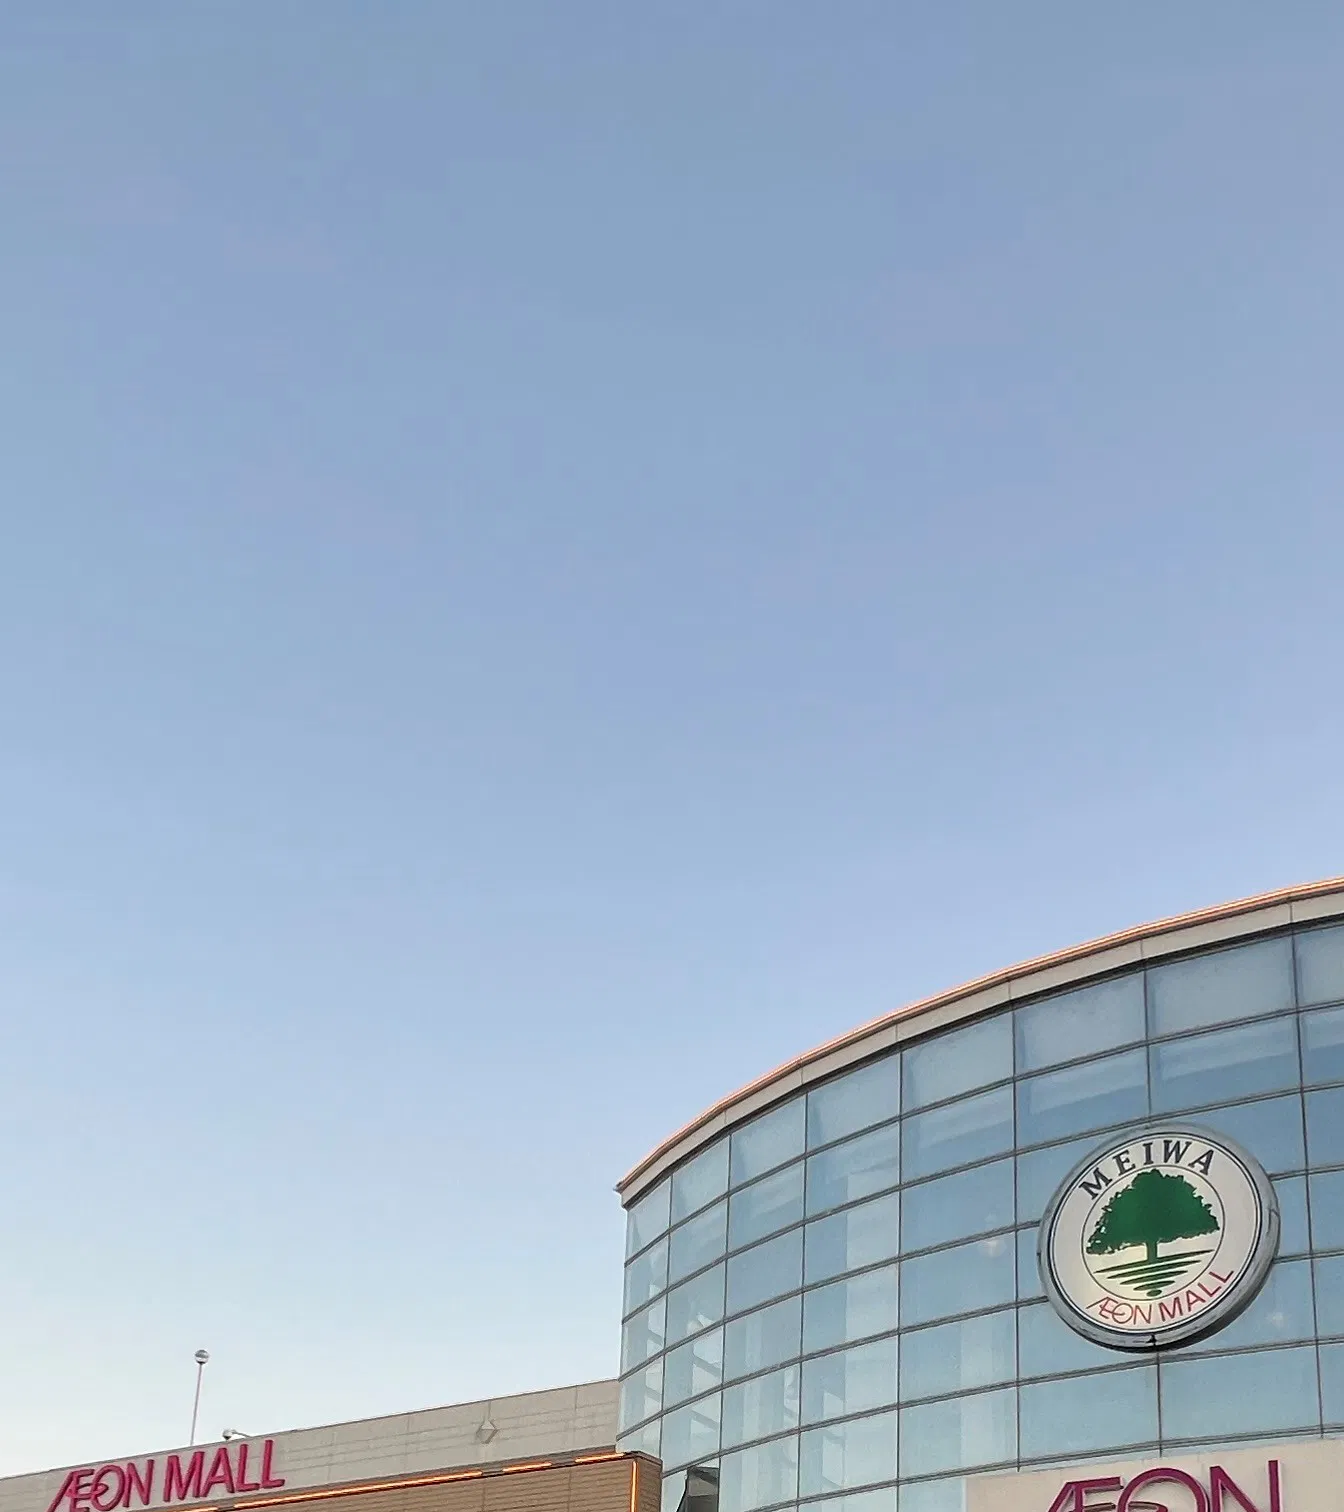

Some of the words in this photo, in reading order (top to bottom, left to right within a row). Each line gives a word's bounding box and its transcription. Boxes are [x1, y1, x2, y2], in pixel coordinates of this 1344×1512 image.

[1078, 1139, 1217, 1200] MEIWA
[1158, 1269, 1235, 1322] MALL
[163, 1439, 285, 1502] MALL
